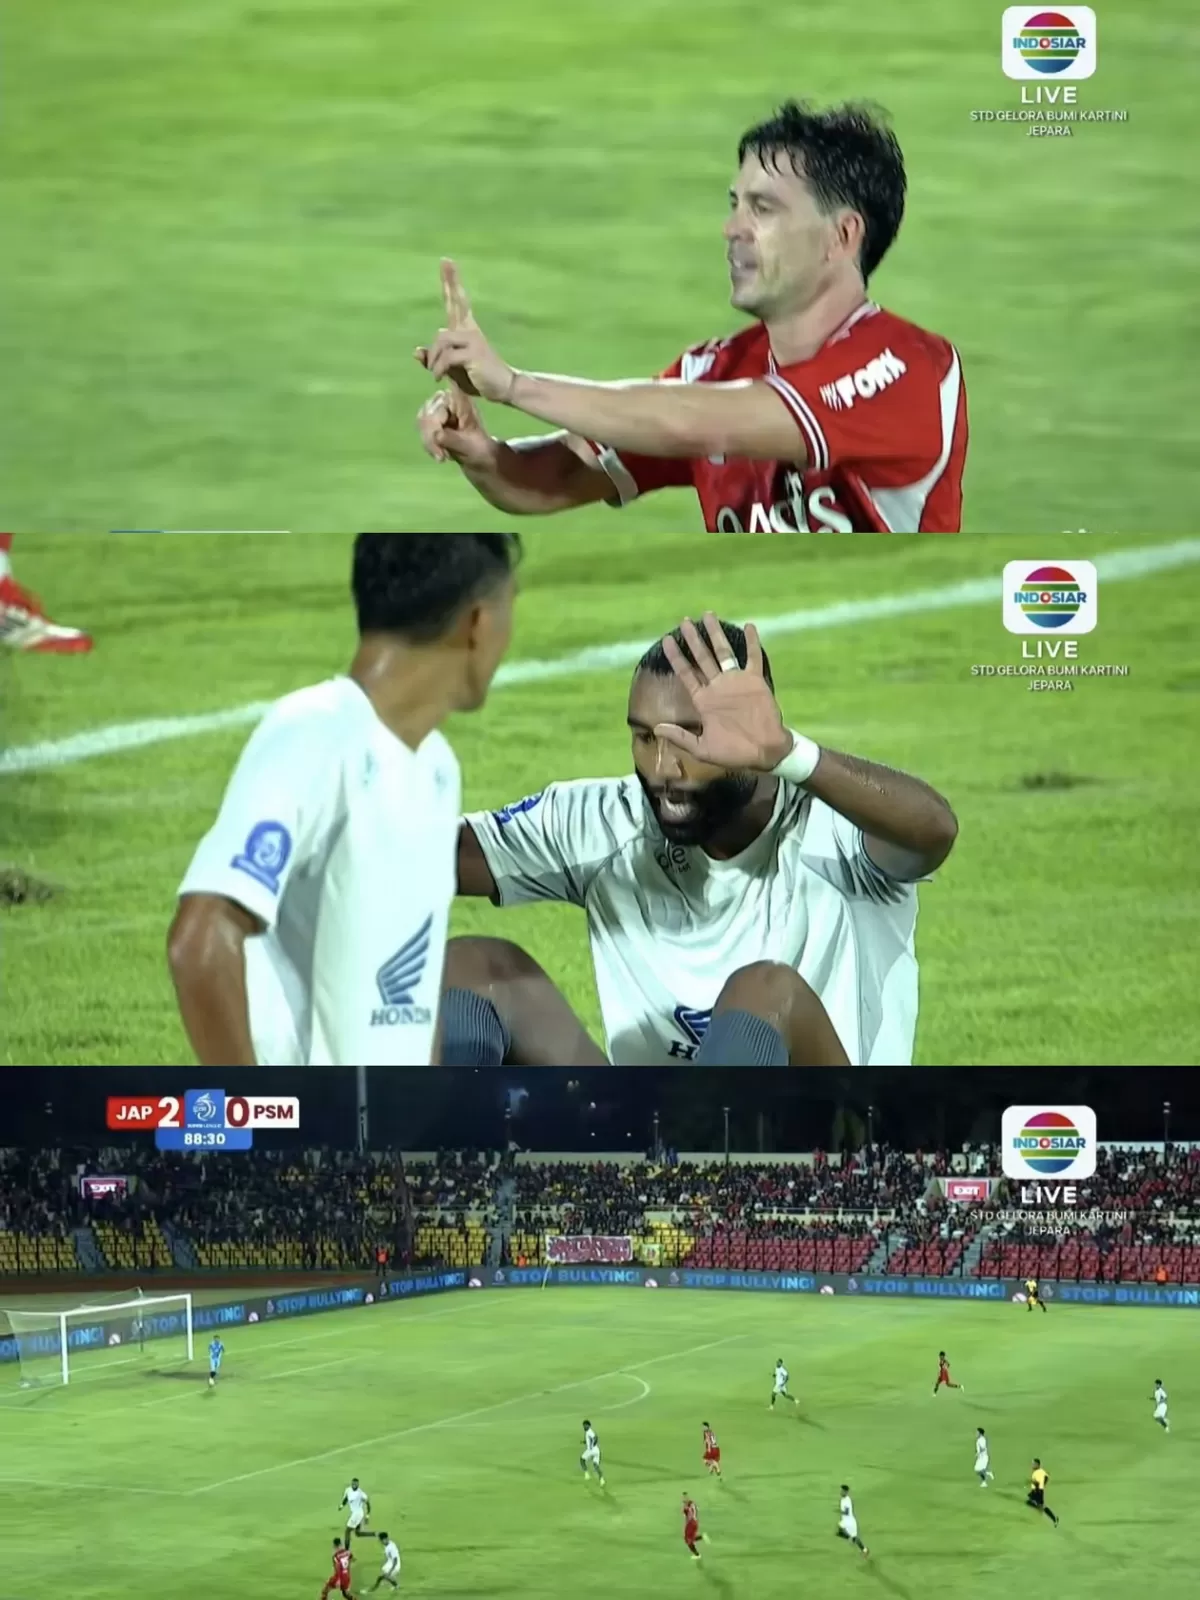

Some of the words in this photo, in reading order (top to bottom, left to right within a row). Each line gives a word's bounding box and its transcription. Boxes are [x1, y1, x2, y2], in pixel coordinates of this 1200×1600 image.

[557, 1269, 641, 1283] BULLYING!
[683, 1273, 726, 1286] STOP
[730, 1274, 815, 1290] BULLYING!
[863, 1280, 908, 1294] STOP
[913, 1282, 1005, 1298] BULLYING!
[1061, 1286, 1109, 1301] STOP
